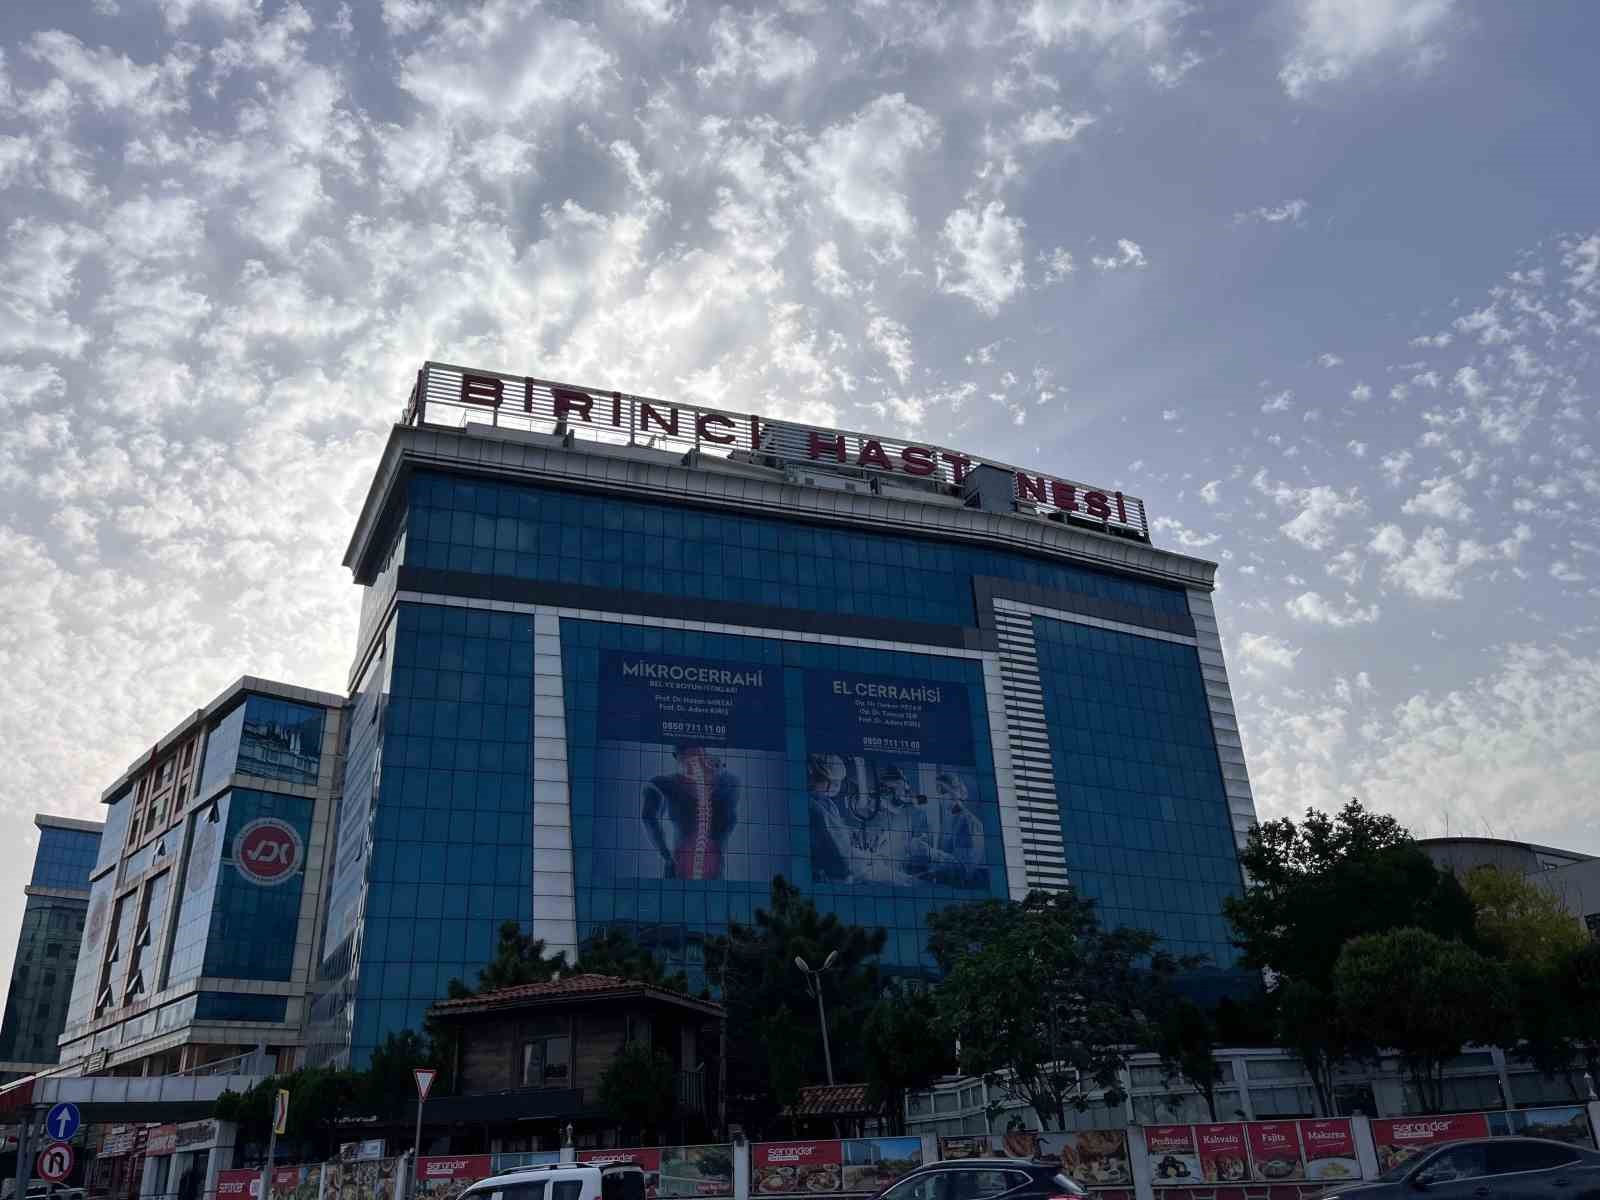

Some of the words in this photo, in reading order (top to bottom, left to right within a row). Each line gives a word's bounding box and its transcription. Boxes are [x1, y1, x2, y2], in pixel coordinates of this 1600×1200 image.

[808, 431, 1127, 523] HASTNESİ
[623, 660, 763, 687] MİKROCERRAHİ
[832, 680, 854, 696] EL
[855, 682, 942, 704] CERRAHİSİ
